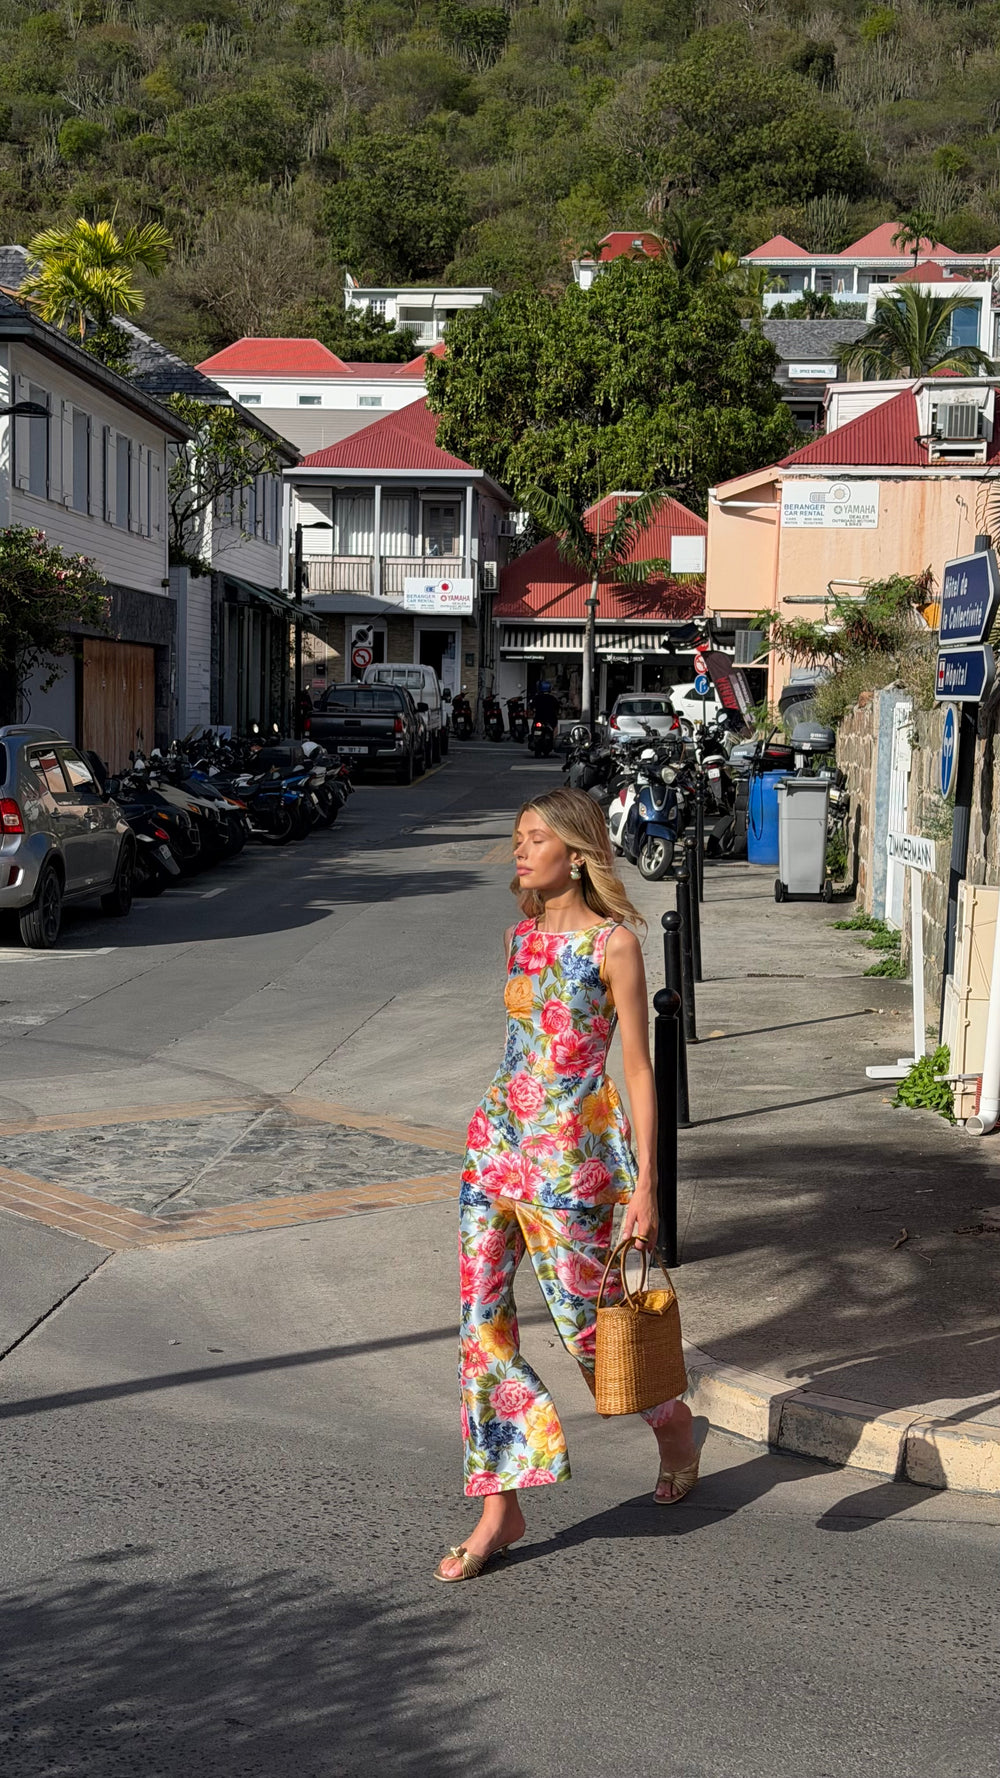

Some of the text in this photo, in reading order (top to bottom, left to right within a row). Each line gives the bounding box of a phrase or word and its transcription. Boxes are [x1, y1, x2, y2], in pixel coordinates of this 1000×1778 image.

[784, 503, 826, 511] BERANGER
[843, 505, 876, 514] YAMAHA
[944, 572, 968, 598] Hôtel de
[942, 602, 982, 630] la Collectivité
[945, 662, 967, 691] Hôpital
[889, 834, 931, 868] ZIMMERMANN
